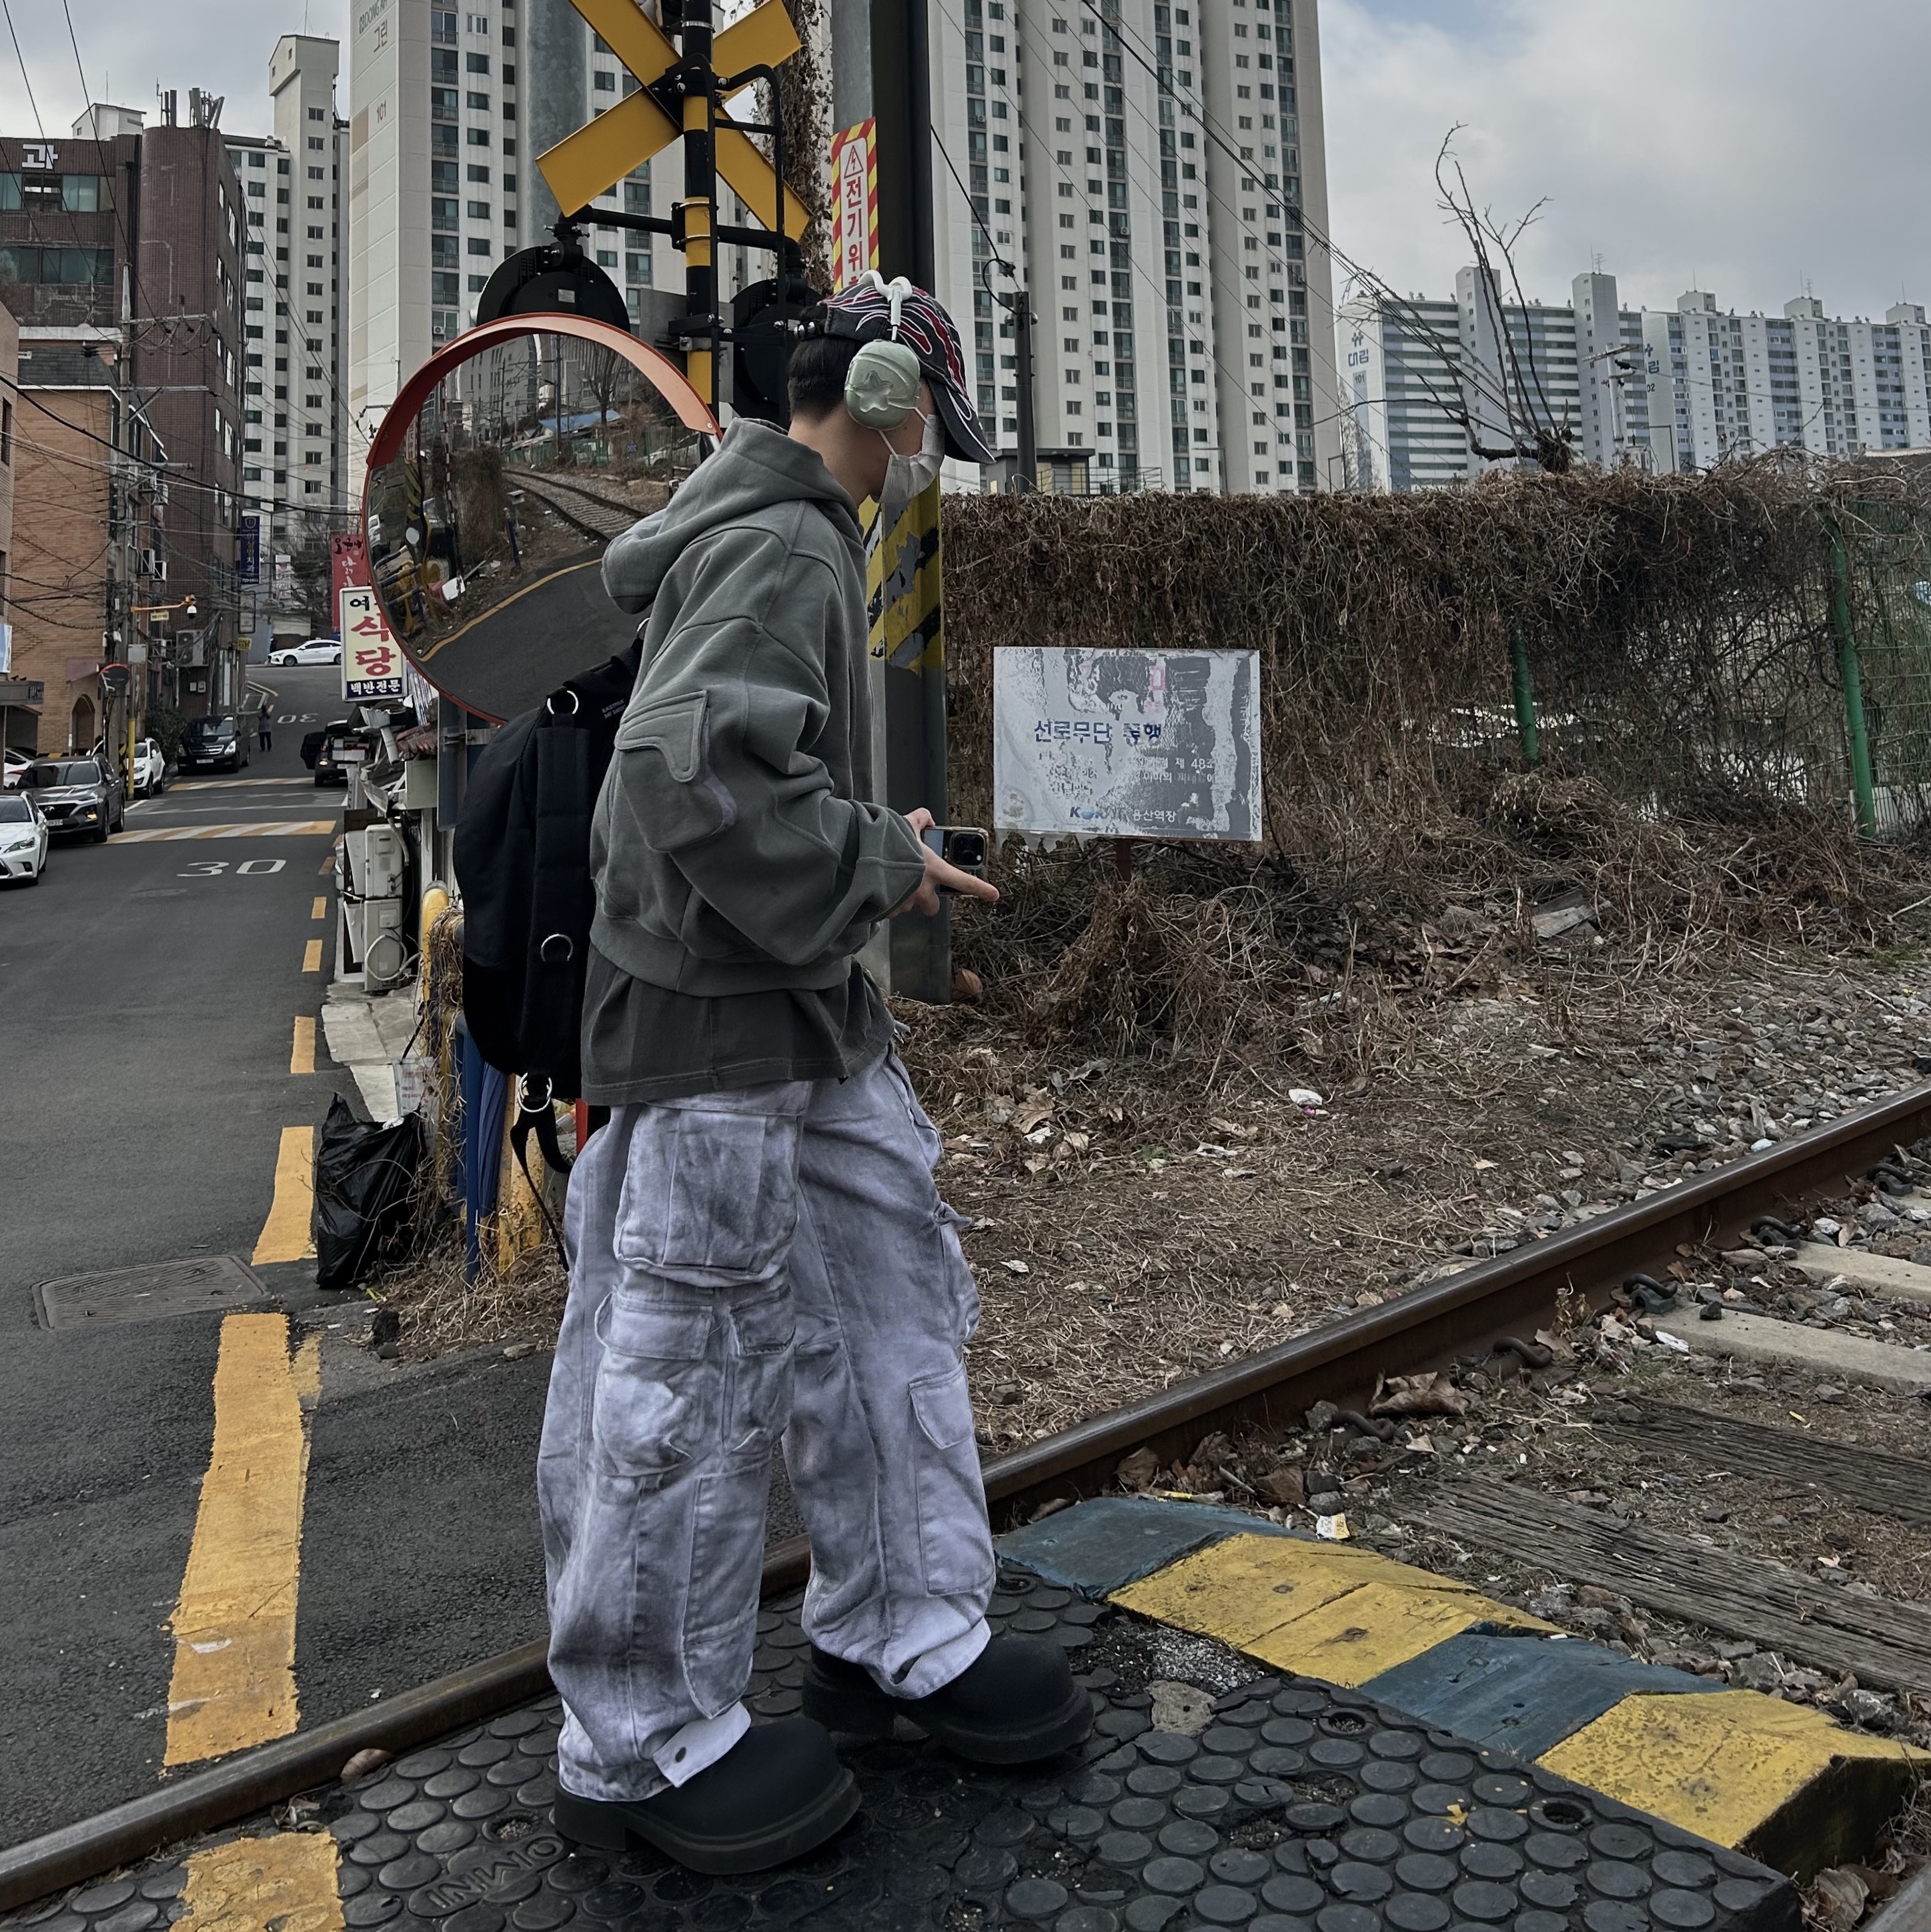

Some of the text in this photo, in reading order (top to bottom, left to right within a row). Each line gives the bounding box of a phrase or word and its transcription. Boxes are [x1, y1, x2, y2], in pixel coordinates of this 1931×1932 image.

[373, 19, 388, 53] 그린
[376, 100, 387, 123] 101
[22, 144, 58, 169] 과
[1348, 348, 1369, 367] 대림
[1646, 360, 1660, 375] 림
[1355, 373, 1365, 384] 101
[351, 613, 396, 676] 식당
[350, 679, 400, 696] 백반전문
[1034, 720, 1112, 744] 선로무단
[177, 860, 286, 876] 30
